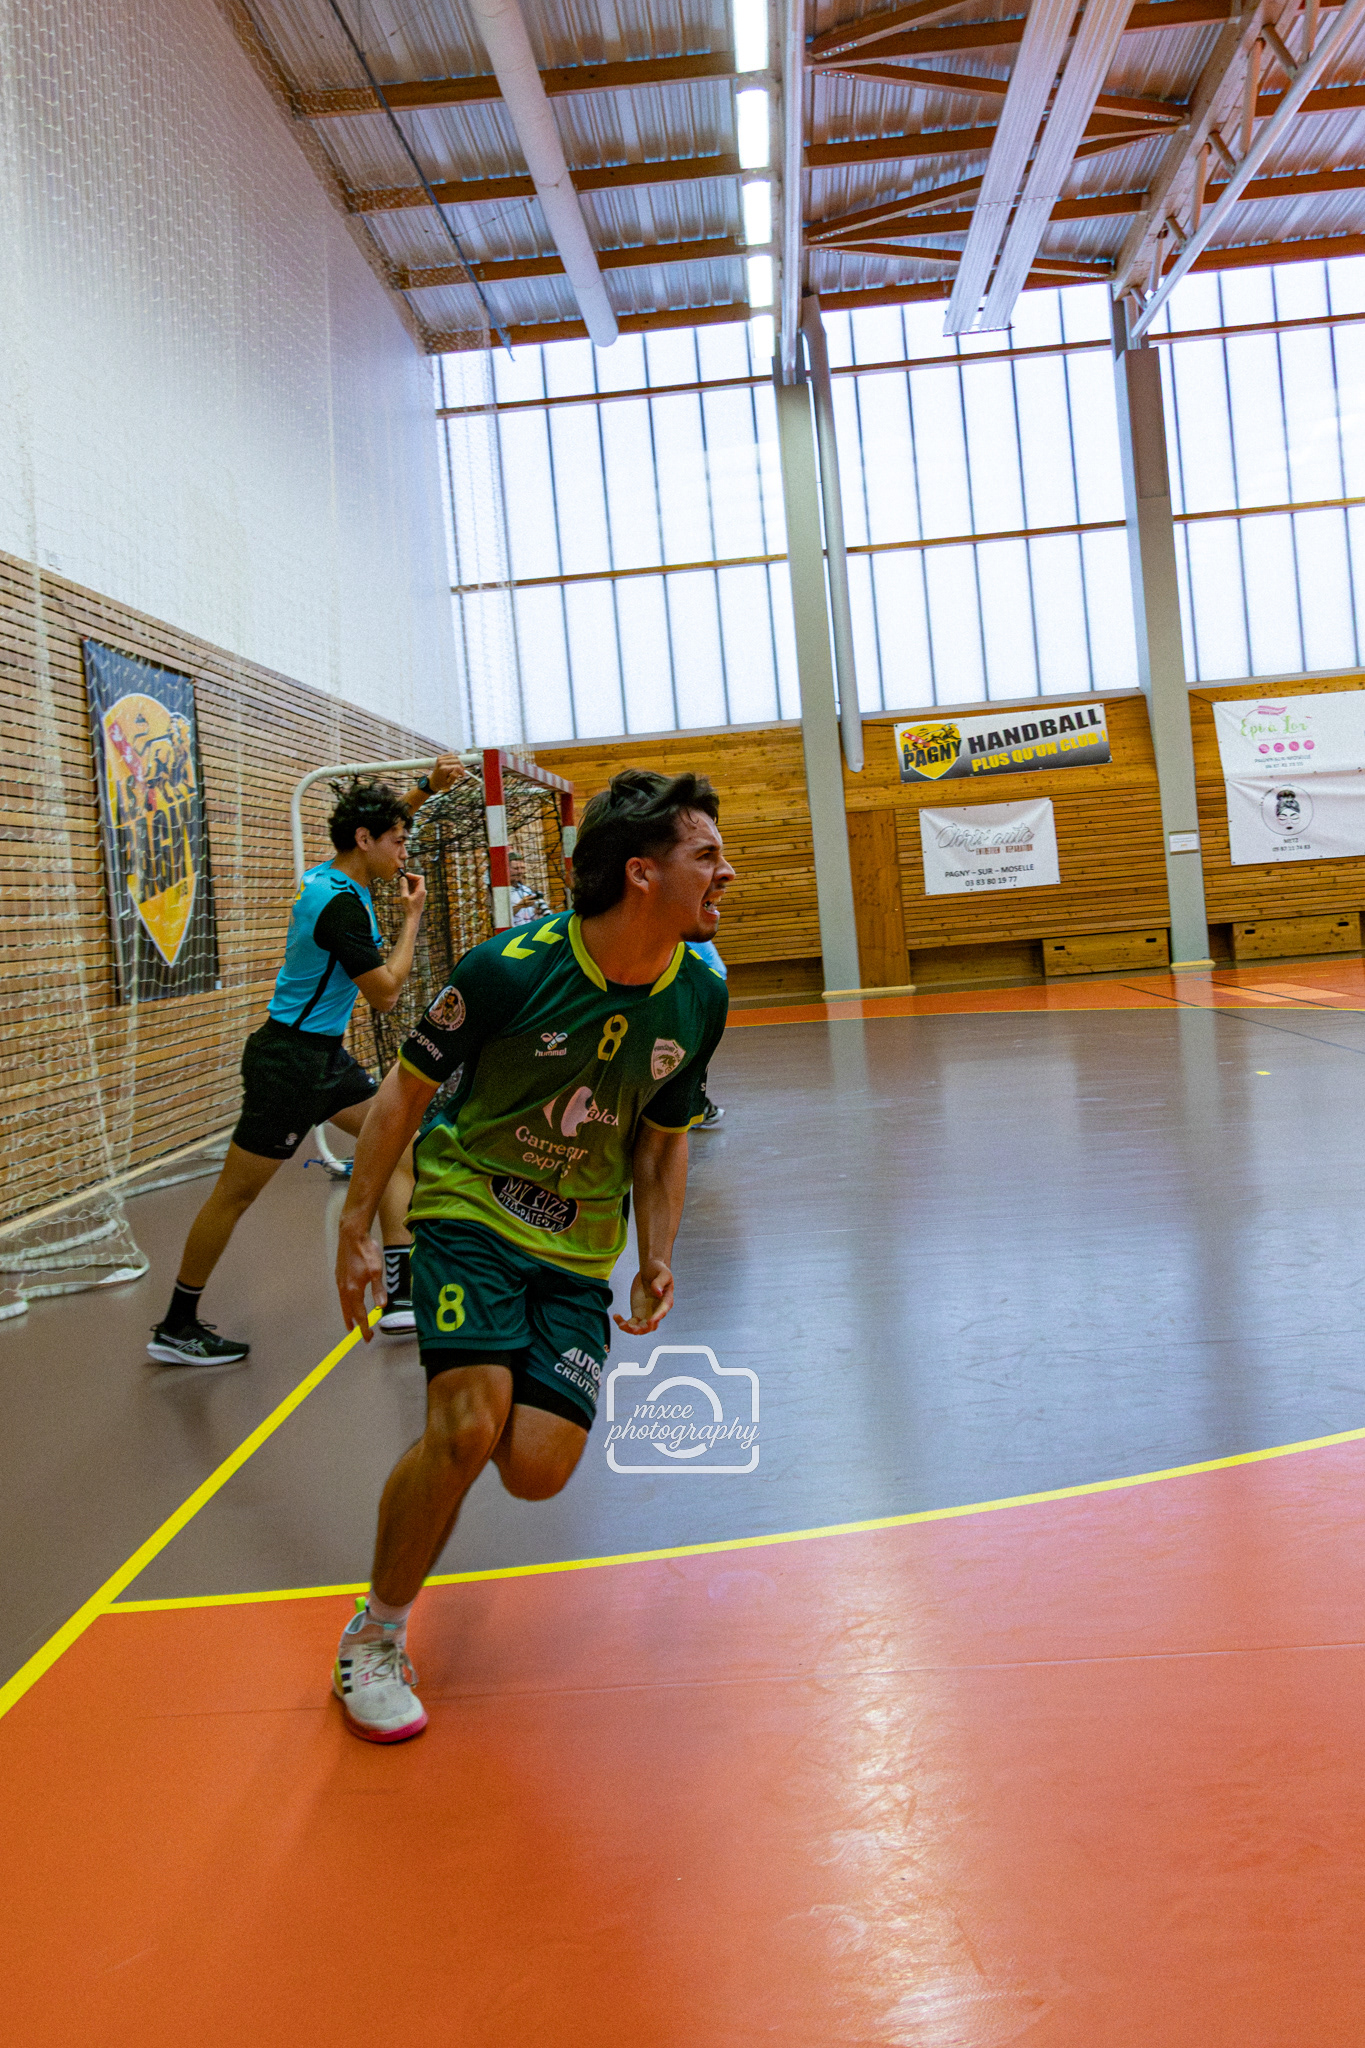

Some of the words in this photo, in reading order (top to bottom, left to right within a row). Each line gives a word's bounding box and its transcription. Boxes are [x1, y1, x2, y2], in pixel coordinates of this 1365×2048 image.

[967, 708, 1102, 755] HANDBALL
[903, 739, 962, 771] PAGNY
[971, 752, 1011, 773] PLUS
[1011, 741, 1058, 764] QU'UN
[1059, 731, 1099, 752] CLUB
[944, 869, 970, 878] PAGNY
[977, 867, 993, 876] SUR
[1000, 863, 1034, 873] MOSELLE
[965, 879, 974, 887] 03
[535, 1047, 567, 1057] hummel
[598, 1014, 629, 1062] 8
[531, 1190, 570, 1224] PIZZ
[436, 1283, 466, 1332] 8
[561, 1346, 601, 1388] AUTO
